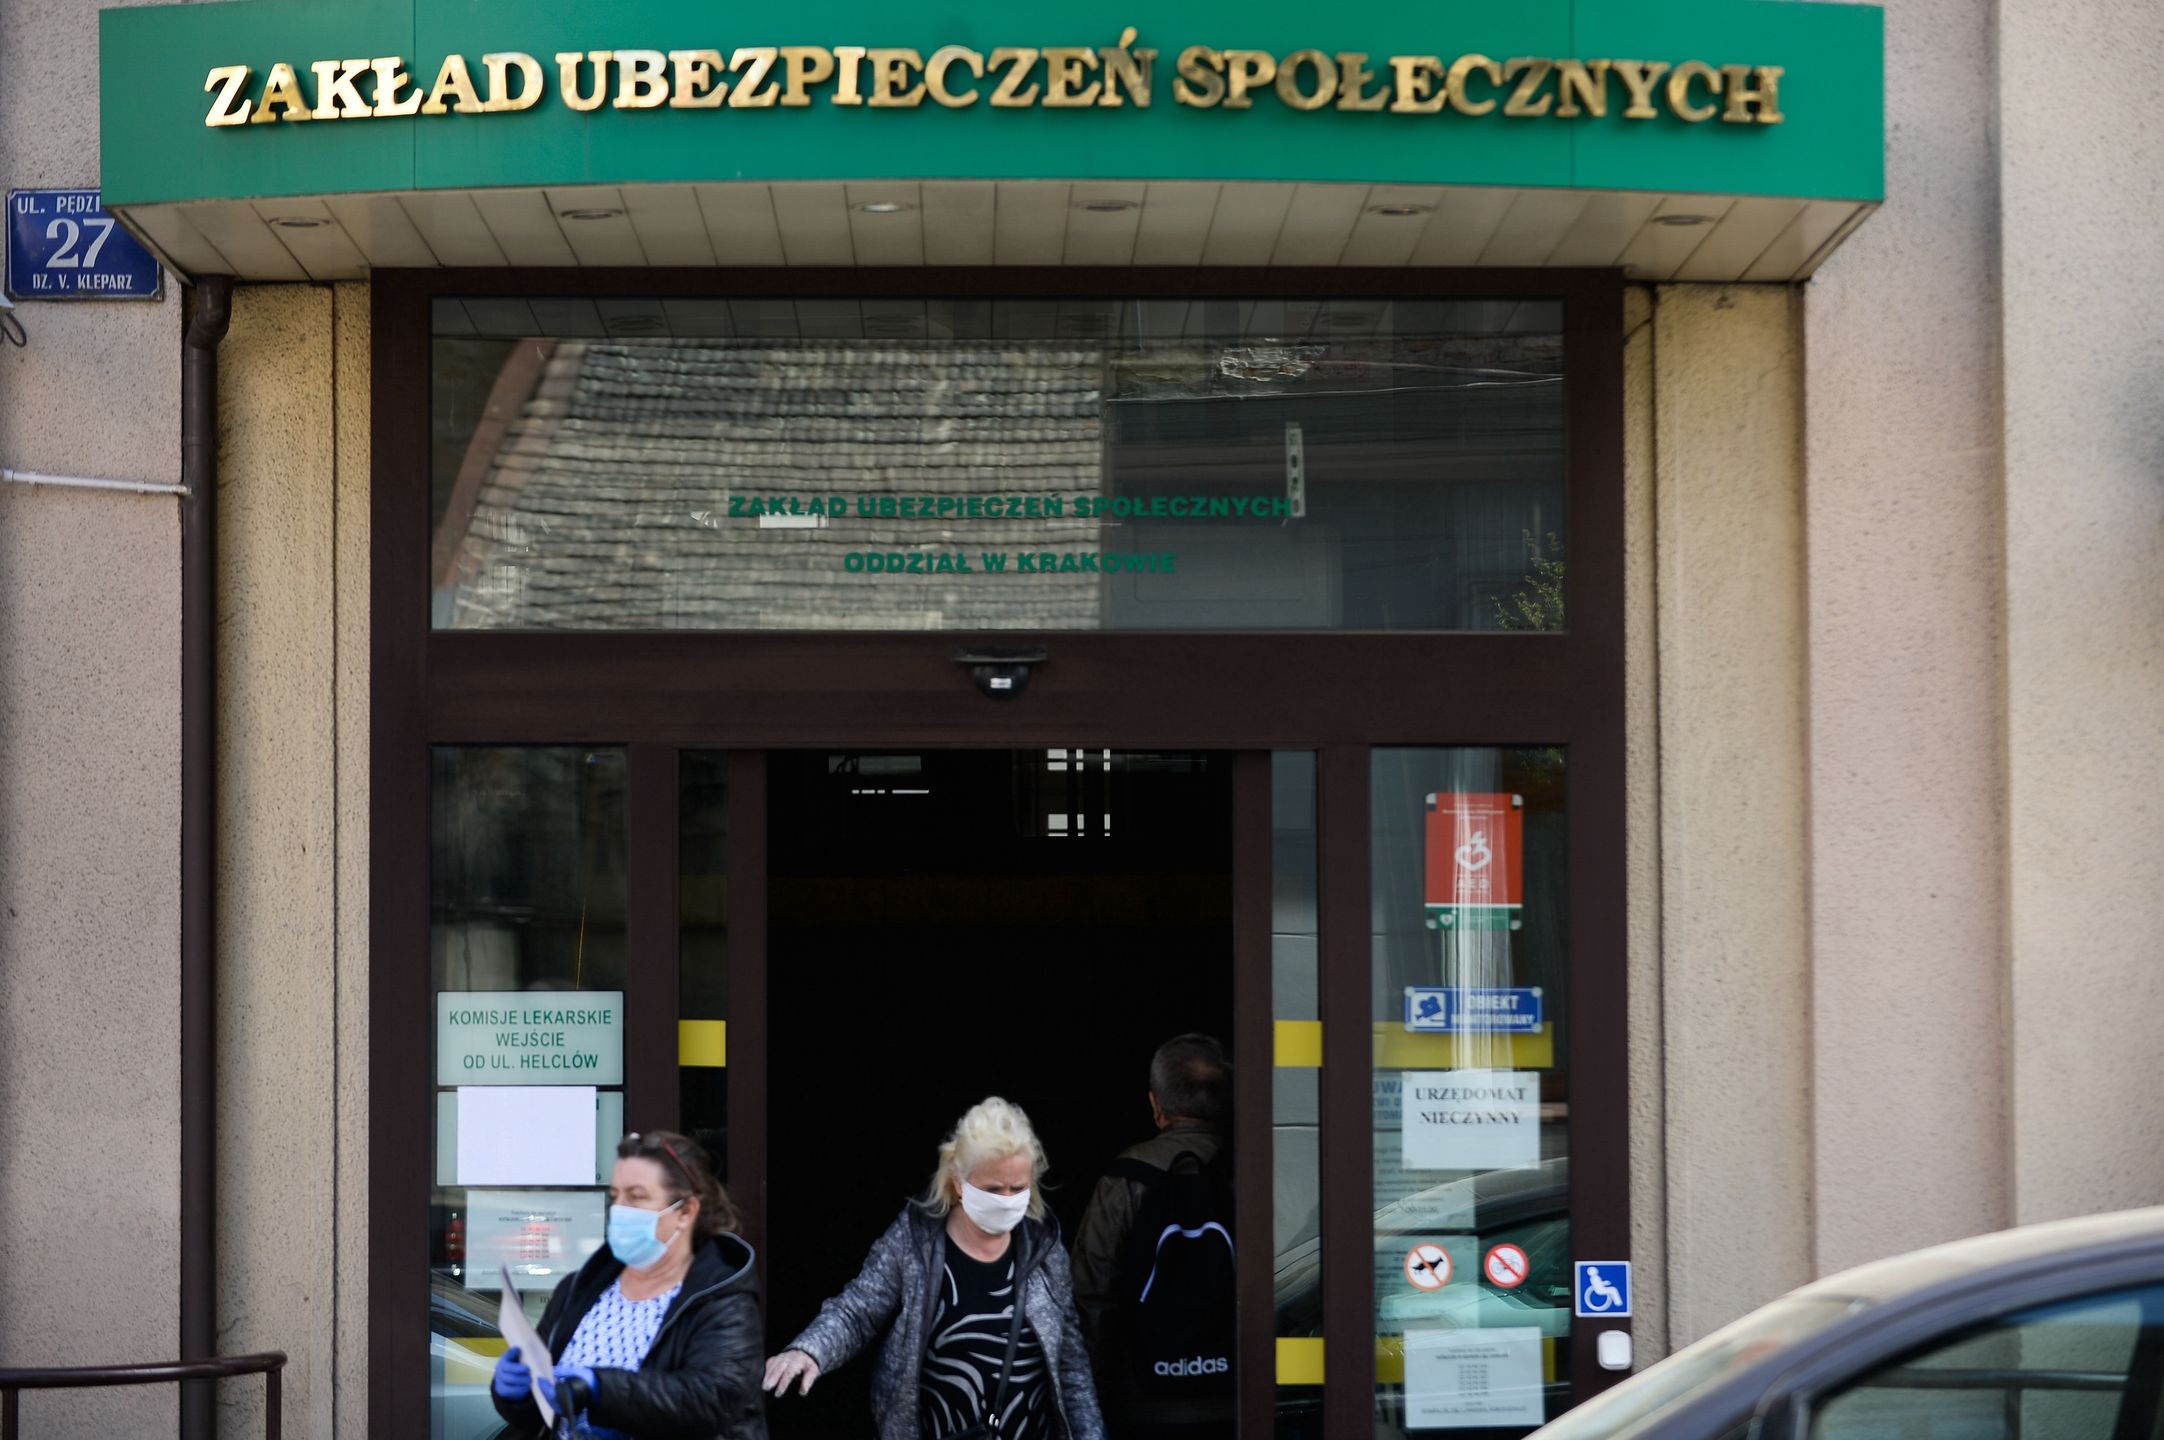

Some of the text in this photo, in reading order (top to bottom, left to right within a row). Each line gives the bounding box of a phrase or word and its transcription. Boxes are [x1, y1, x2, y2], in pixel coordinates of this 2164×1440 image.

[204, 27, 1785, 127] ZAKŁAD UBEZPIECZEŃ SPOŁECZNYCH
[17, 195, 101, 215] UL. PĘDZI
[46, 217, 116, 268] 27
[32, 274, 133, 290] DZ. V. KLEPARZ
[728, 492, 1293, 518] ZAKŁAD UBEZPIECZEŃ SPOŁECZNYCH
[843, 552, 1177, 574] ODDZIAŁ W KRAKOWIE
[449, 1009, 612, 1025] KOMISJE LEKARSKIE
[496, 1028, 565, 1047] WEJŚCIE
[463, 1050, 599, 1069] OD UL. HELCLÓW
[1415, 1087, 1526, 1103] URZĘDOMAT
[1419, 1111, 1523, 1125] NIECZYNNY
[1154, 1355, 1229, 1376] adidas
